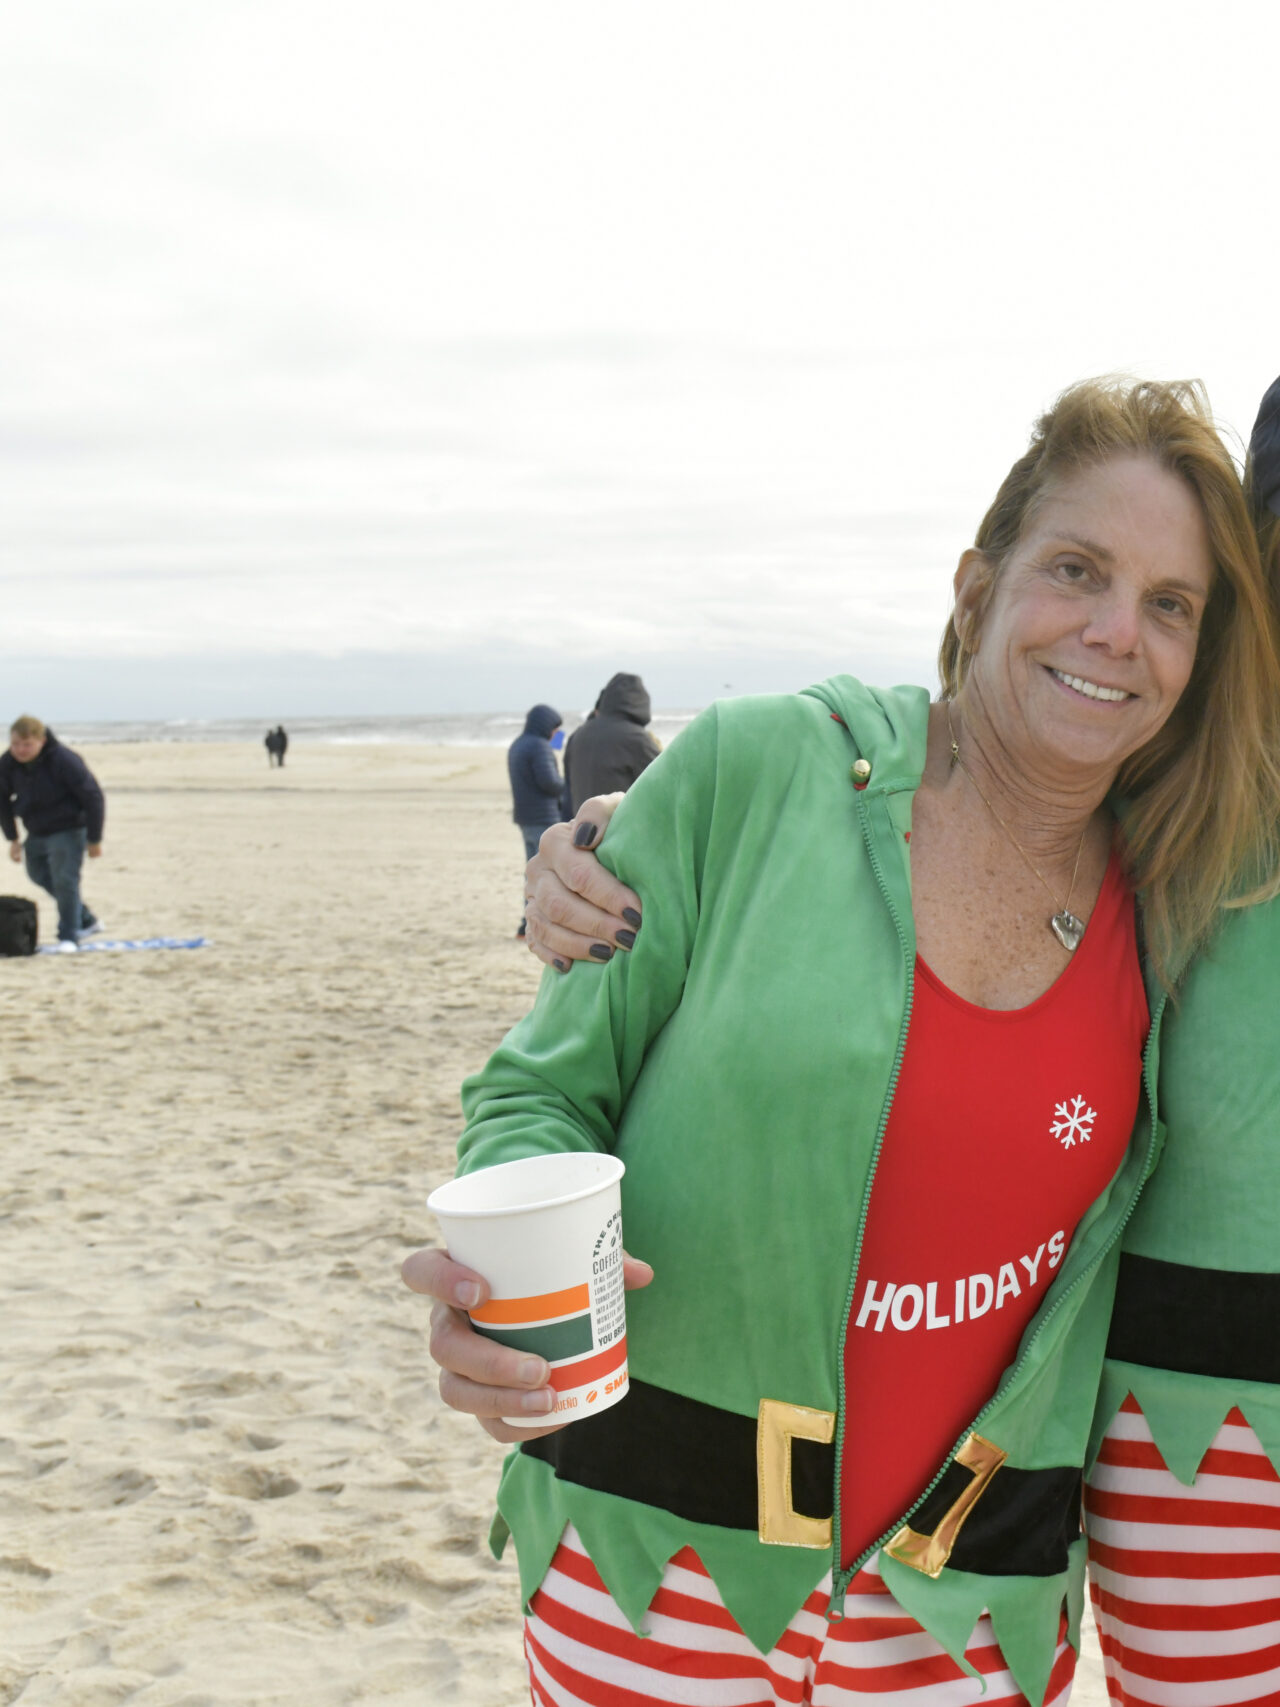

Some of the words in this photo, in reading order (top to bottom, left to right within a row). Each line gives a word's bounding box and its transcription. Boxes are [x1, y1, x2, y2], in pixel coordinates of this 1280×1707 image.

[592, 1230, 607, 1258] THE
[592, 1248, 618, 1275] COFFEE
[855, 1230, 1065, 1333] HOLIDAYS
[598, 1332, 613, 1346] YOU
